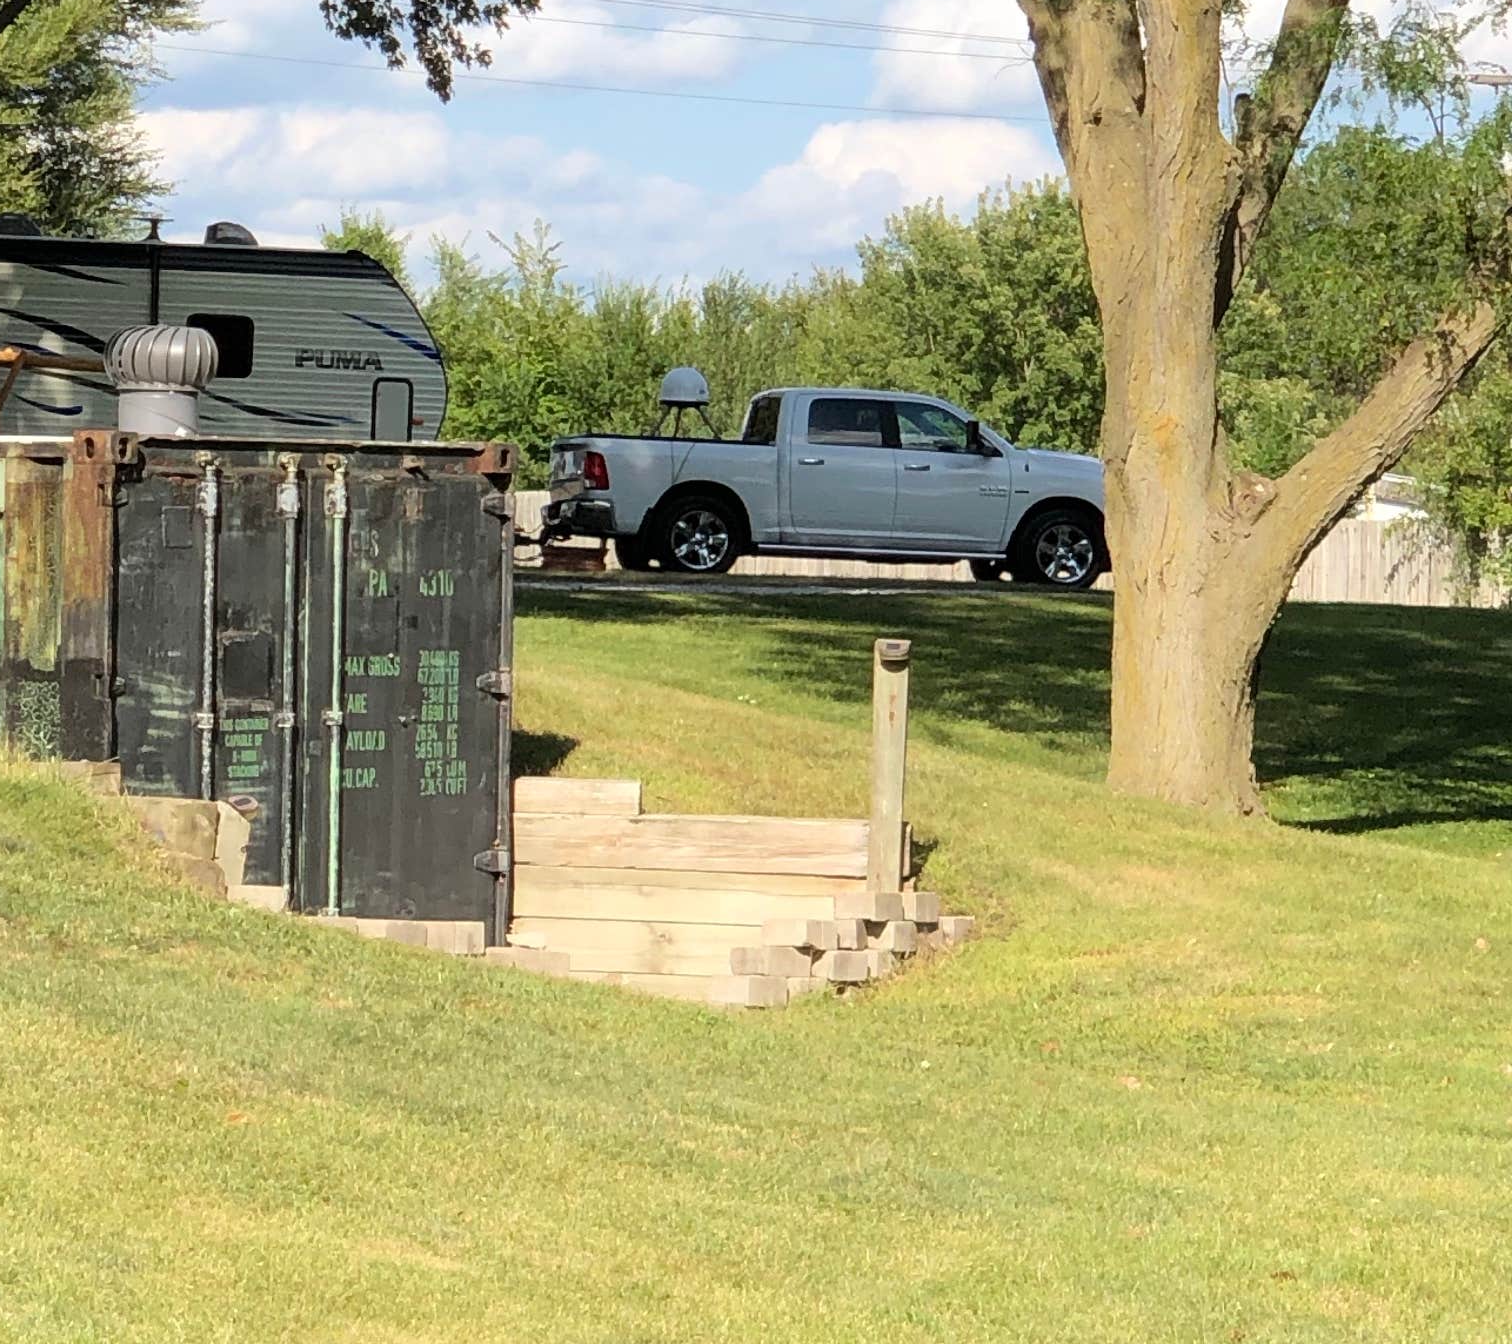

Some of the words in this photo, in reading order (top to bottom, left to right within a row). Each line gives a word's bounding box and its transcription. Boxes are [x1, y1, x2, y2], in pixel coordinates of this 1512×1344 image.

[295, 349, 384, 370] PUMA
[368, 568, 387, 596] PA
[368, 656, 400, 676] GROSS
